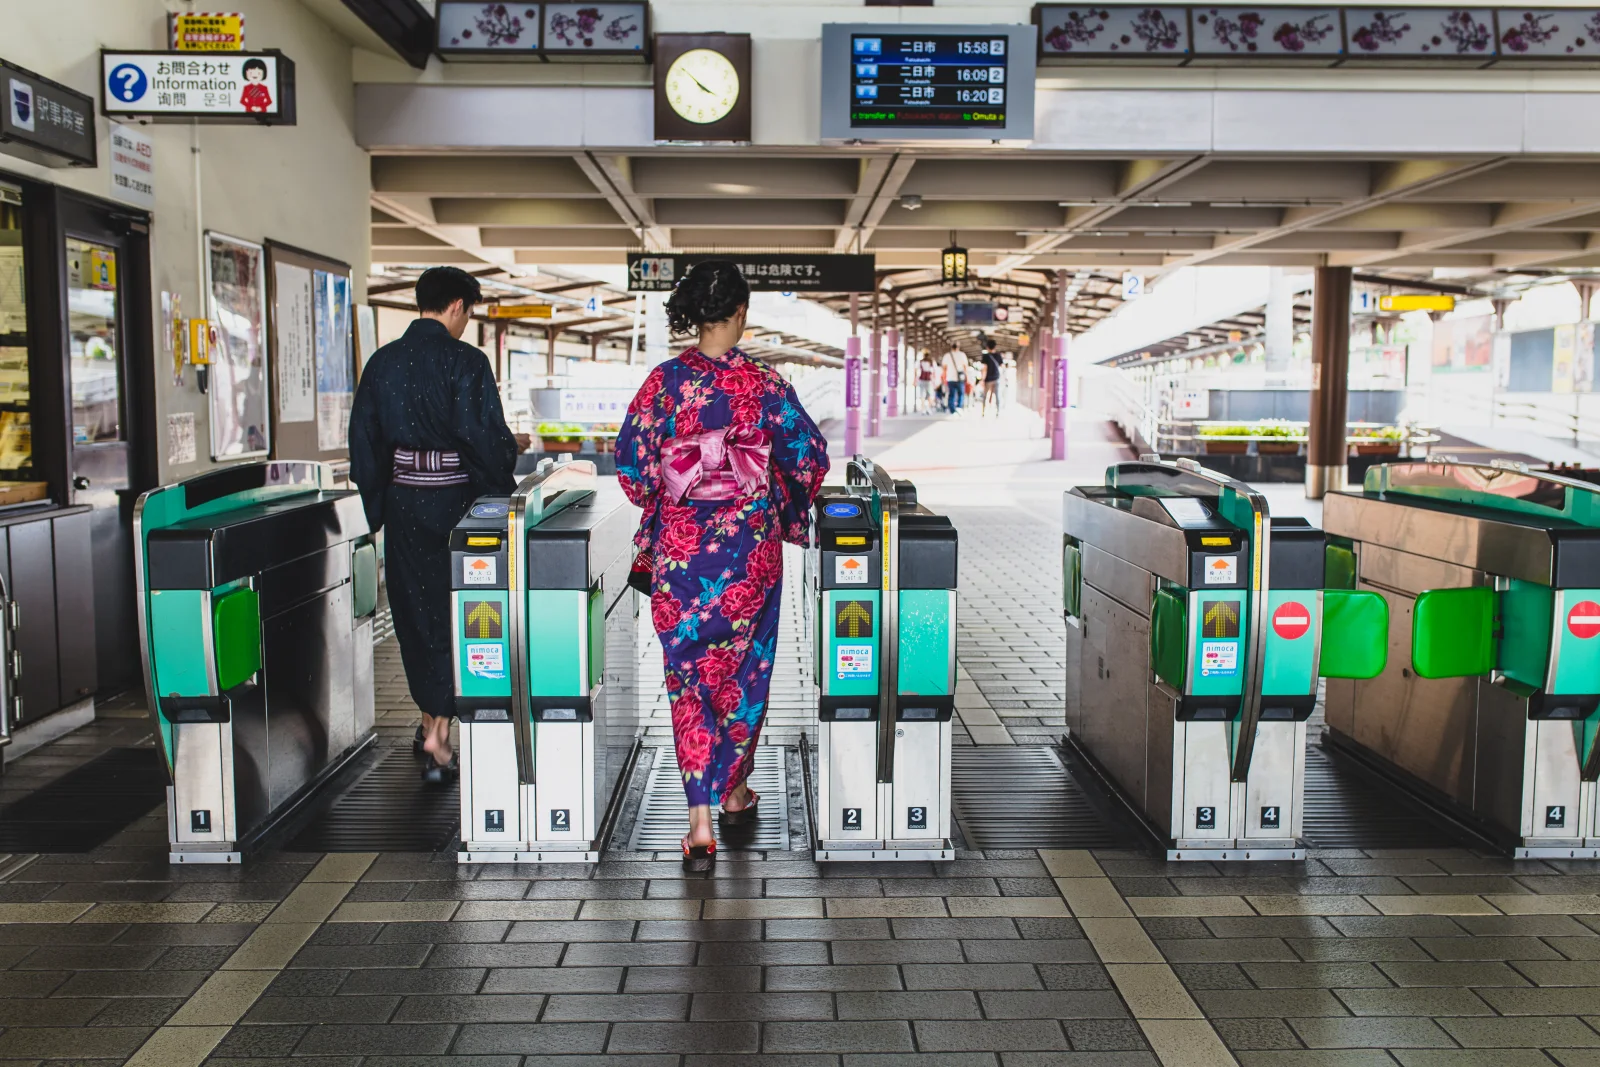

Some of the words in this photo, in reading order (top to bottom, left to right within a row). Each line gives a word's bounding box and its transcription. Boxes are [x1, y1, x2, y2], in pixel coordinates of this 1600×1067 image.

[900, 42, 936, 53] 二日市
[957, 42, 988, 54] 15:58
[157, 61, 230, 76] お問合わせ
[900, 66, 936, 78] 二日市
[956, 69, 988, 81] 16:09
[152, 77, 237, 90] Information
[204, 92, 231, 107] 문의
[900, 86, 935, 98] 二日市
[956, 90, 987, 102] 16:20
[36, 95, 84, 136] 駅事務室
[1128, 276, 1139, 294] 2
[586, 297, 596, 311] 4
[1360, 292, 1368, 308] 1
[196, 811, 204, 824] 1
[490, 811, 498, 824] 1
[556, 811, 566, 824] 2
[847, 809, 857, 823] 2
[911, 808, 922, 821] 3
[1200, 808, 1211, 821] 3
[1264, 808, 1276, 820] 4
[1549, 807, 1561, 820] 4
